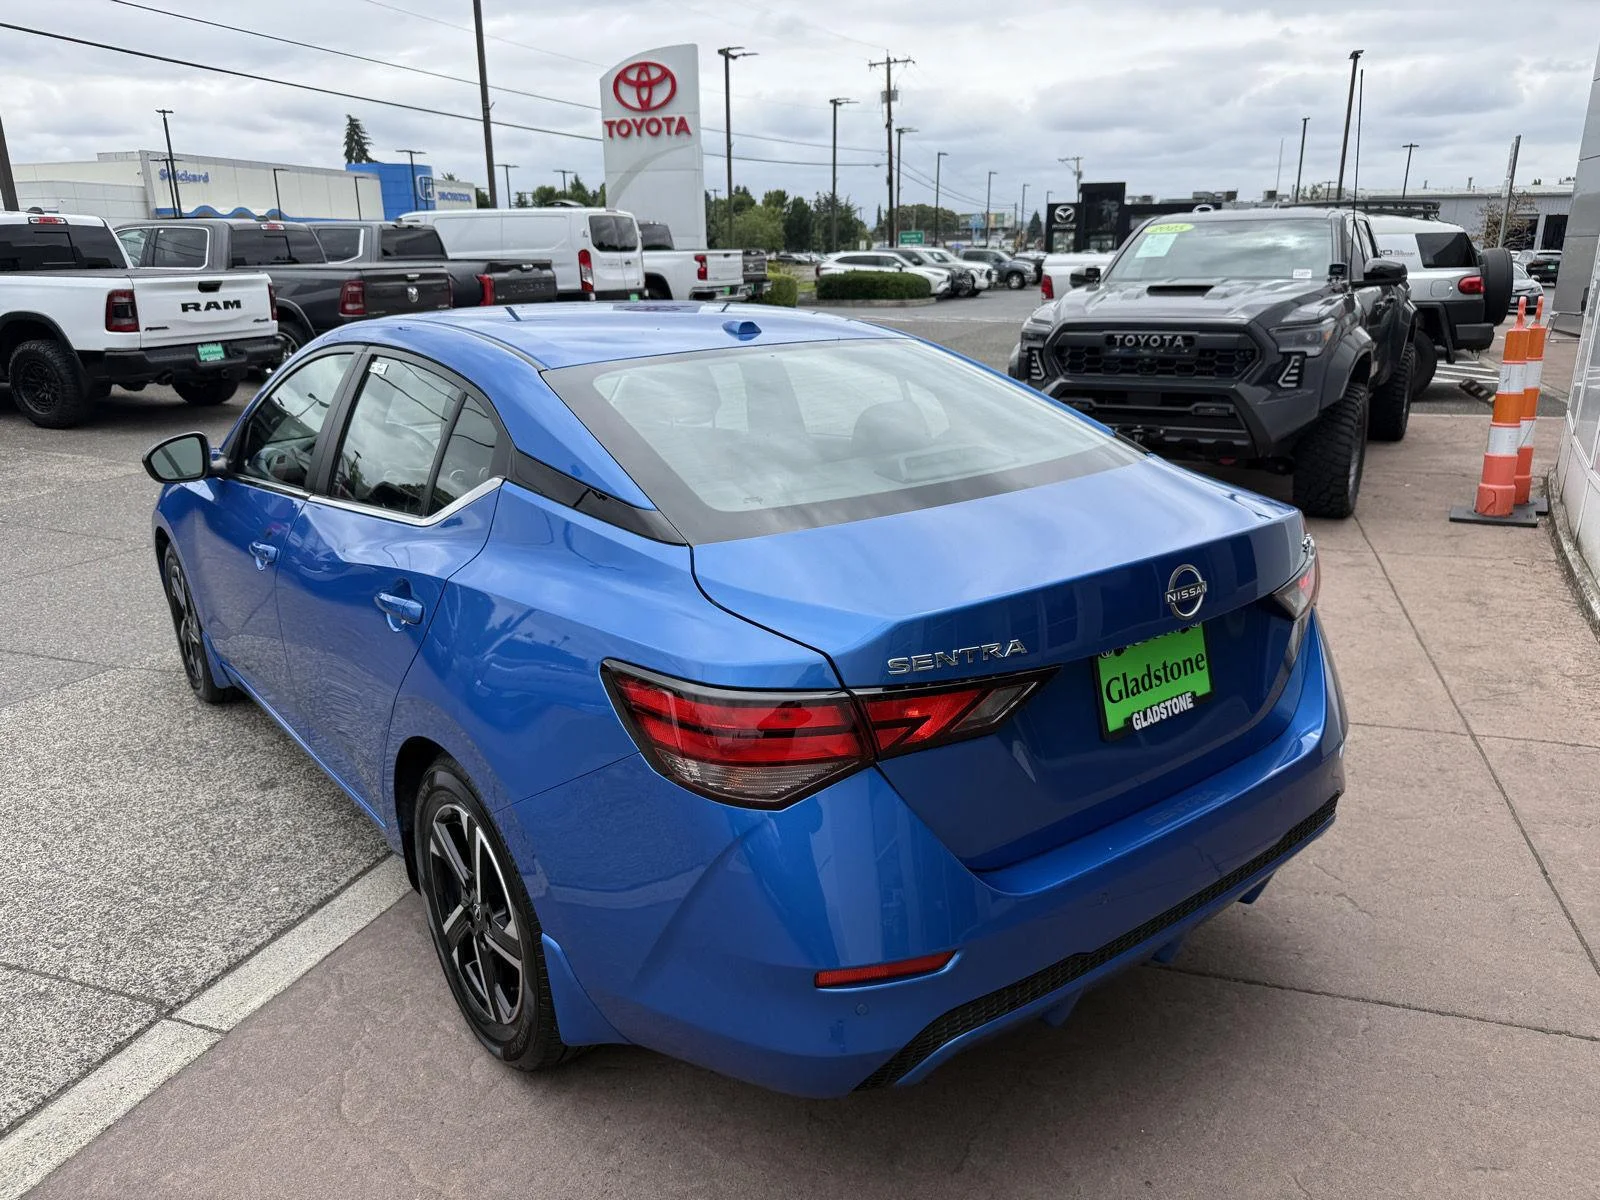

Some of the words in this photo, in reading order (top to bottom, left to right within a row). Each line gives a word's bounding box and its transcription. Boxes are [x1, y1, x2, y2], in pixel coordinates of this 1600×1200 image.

[604, 116, 692, 139] TOYOTA
[181, 300, 242, 312] RAM
[1114, 335, 1185, 348] TOYOTA
[1167, 583, 1207, 603] NISSAN
[888, 639, 1028, 675] SENTRA
[1105, 652, 1206, 704] Gladstone
[1132, 691, 1195, 731] GLADSTONE
